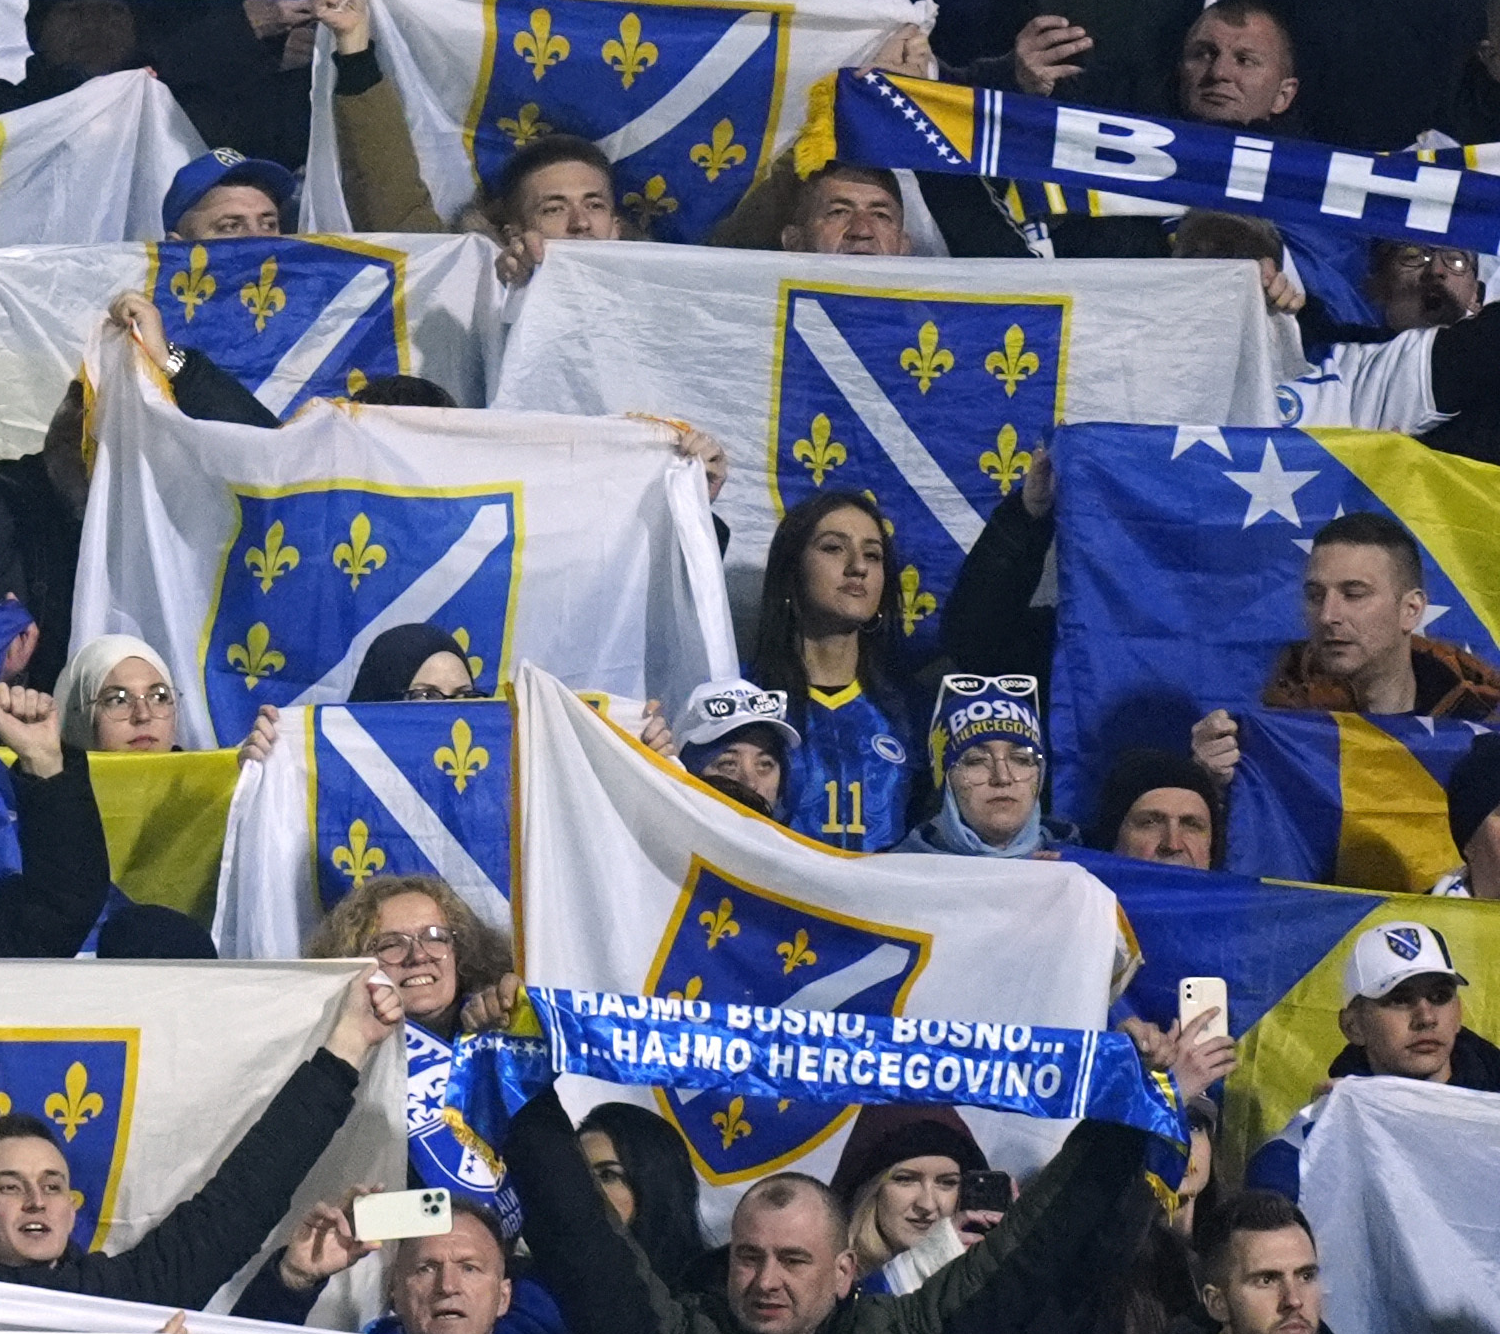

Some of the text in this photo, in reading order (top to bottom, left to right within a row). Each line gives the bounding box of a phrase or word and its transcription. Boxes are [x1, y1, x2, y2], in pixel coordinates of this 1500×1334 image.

[822, 780, 866, 834] 11
[580, 1027, 1064, 1100] ...HAJMO HERCEGOVINO
